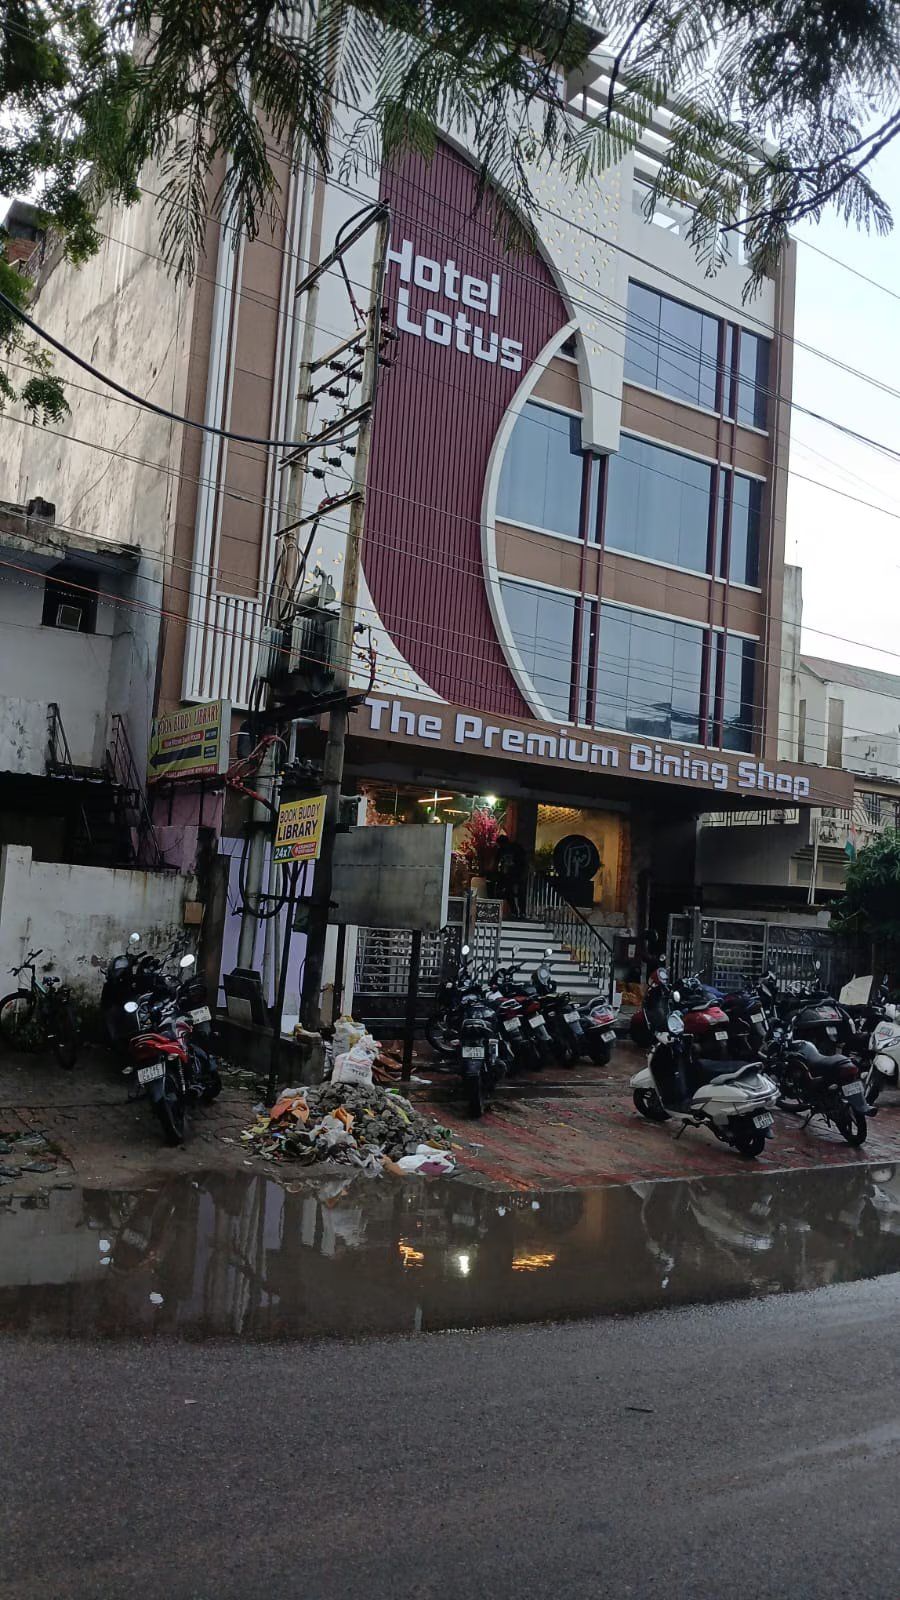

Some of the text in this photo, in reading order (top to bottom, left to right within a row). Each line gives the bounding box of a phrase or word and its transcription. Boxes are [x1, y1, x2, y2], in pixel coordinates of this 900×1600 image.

[385, 234, 500, 317] Hotel
[397, 287, 523, 372] Lotus
[194, 703, 219, 726] LIBRARY
[365, 697, 810, 800] The Premium Dining Shop
[277, 820, 318, 841] LIBRARY
[280, 803, 321, 824] BOOK BUDDY
